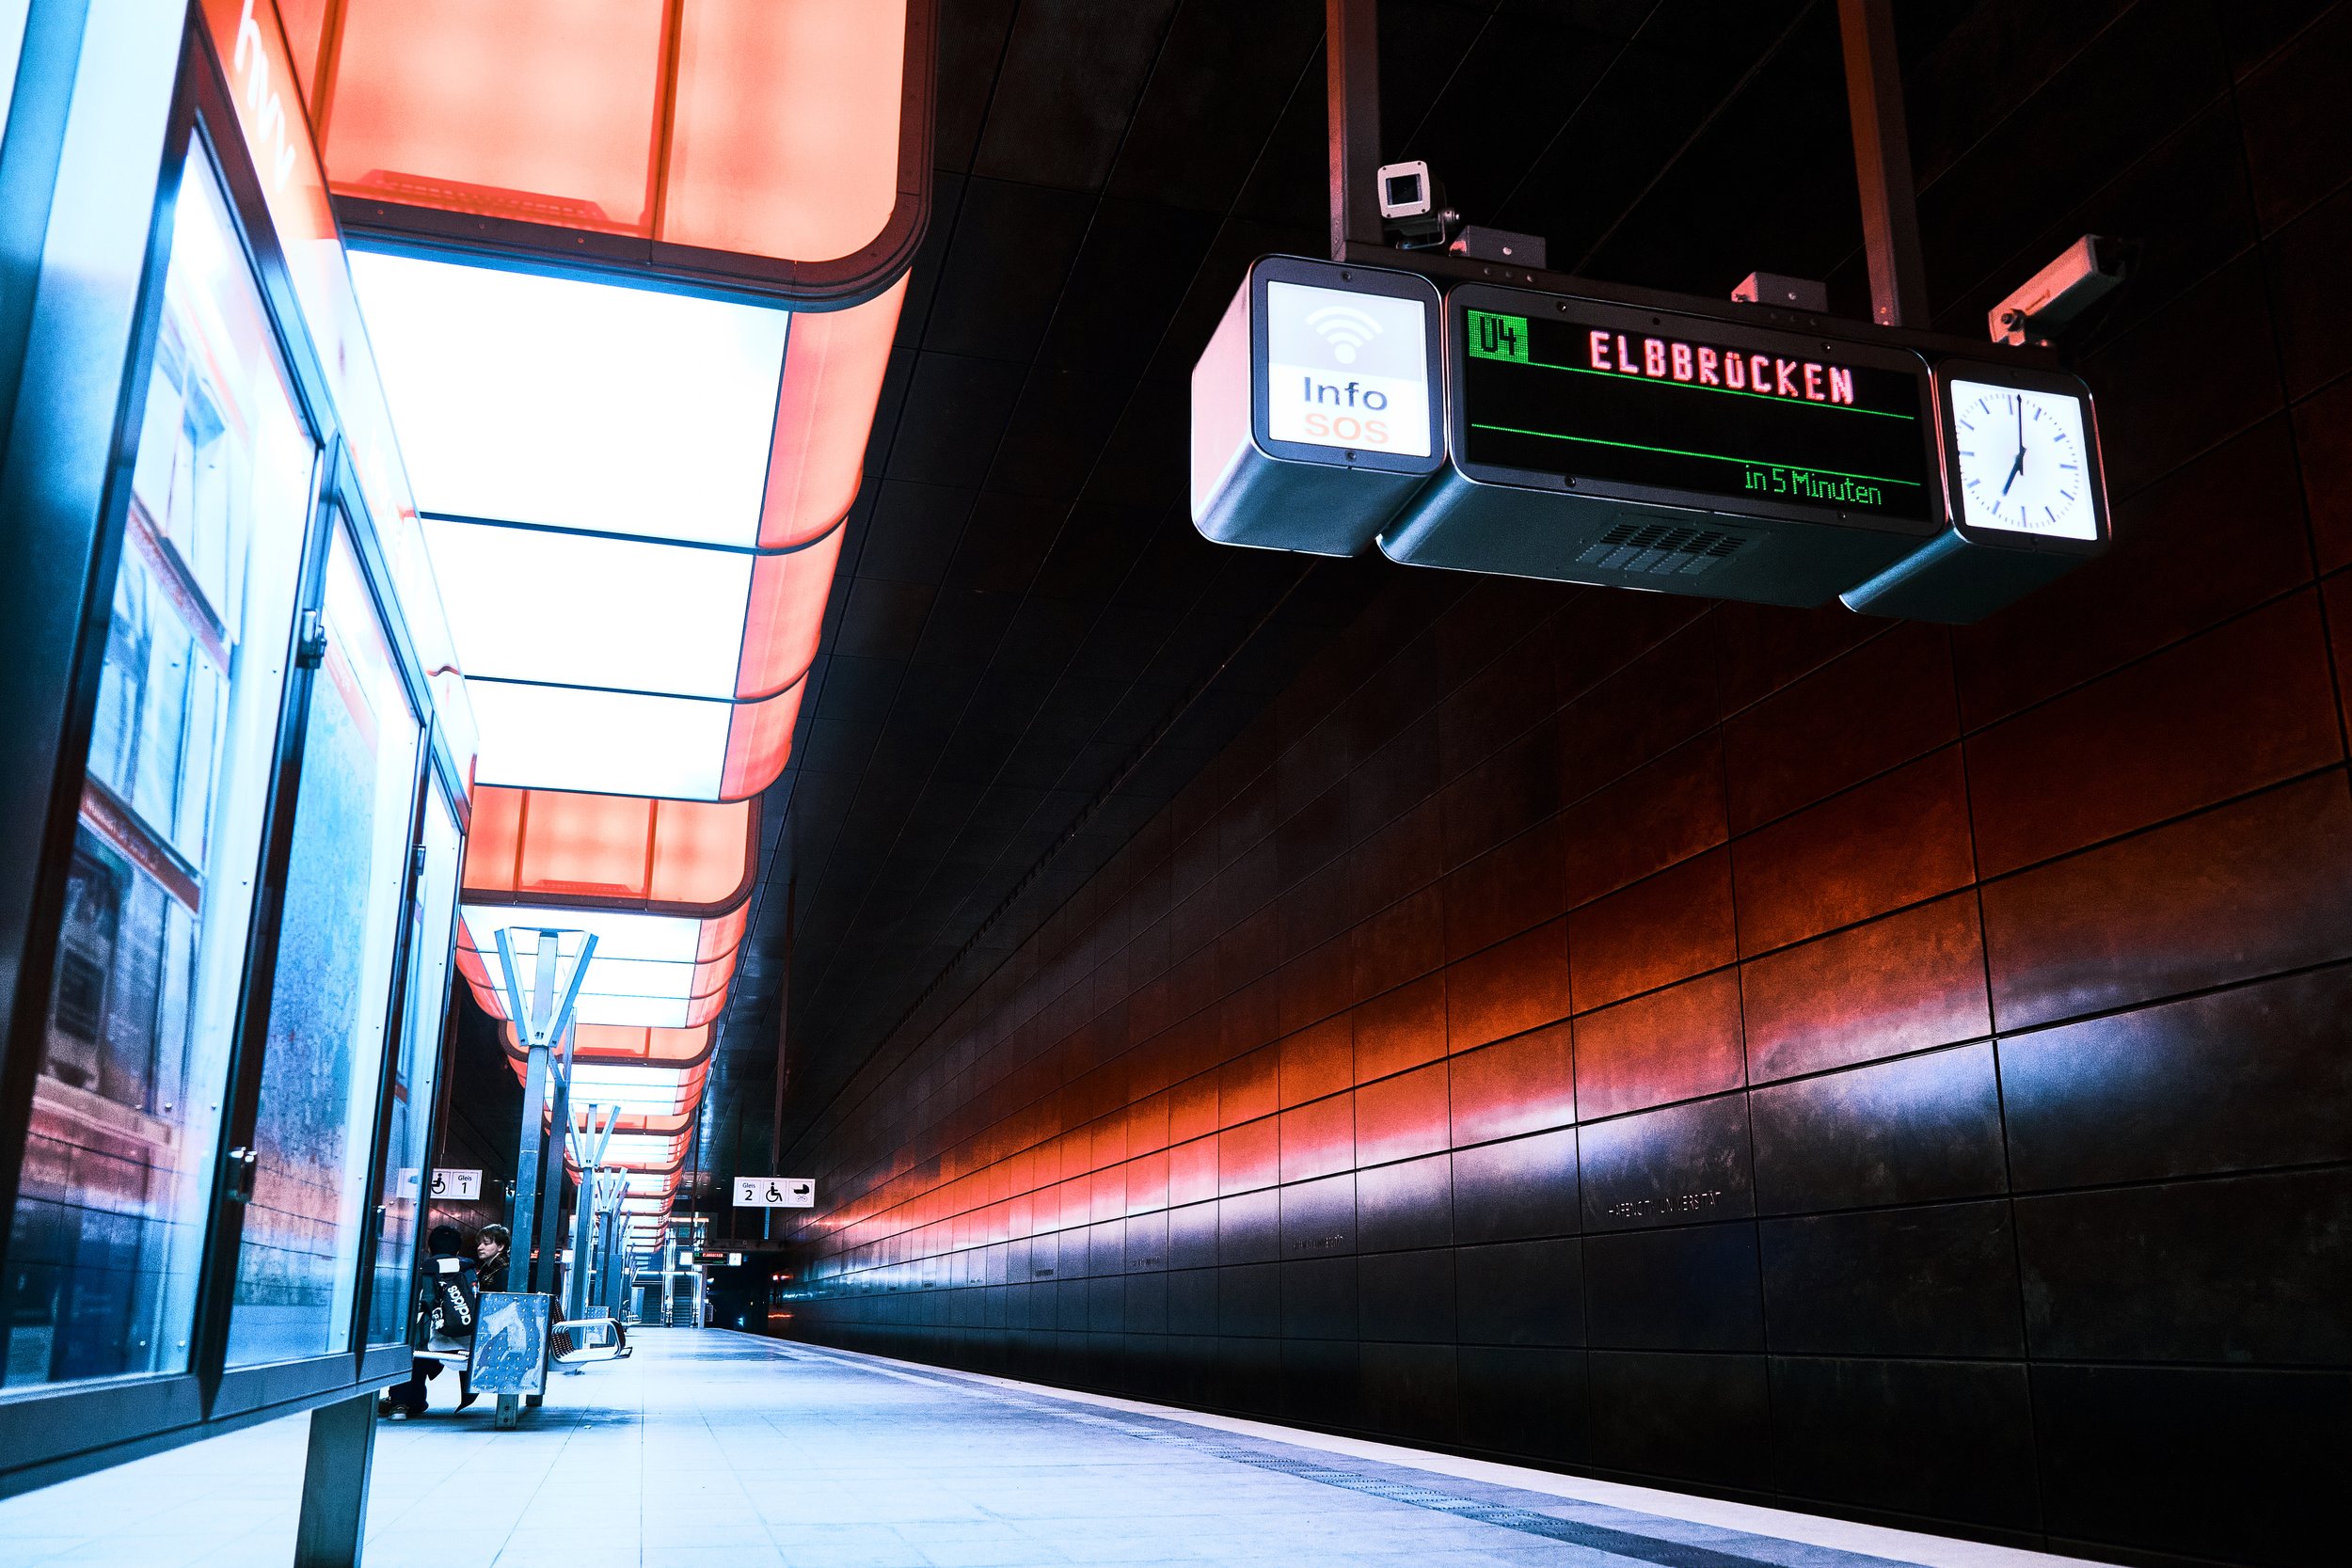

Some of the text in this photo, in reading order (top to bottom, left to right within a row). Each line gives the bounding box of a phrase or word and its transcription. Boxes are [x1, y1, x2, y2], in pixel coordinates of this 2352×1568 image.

[1480, 316, 1518, 356] U4
[1588, 329, 1855, 406] ELBBRÜCKEN
[1303, 375, 1389, 412] Info
[1304, 412, 1390, 445] SOS
[1744, 464, 1883, 506] in 5 Minuten
[461, 1181, 468, 1195] 1
[744, 1189, 754, 1201] 2
[447, 1285, 472, 1326] adidas
